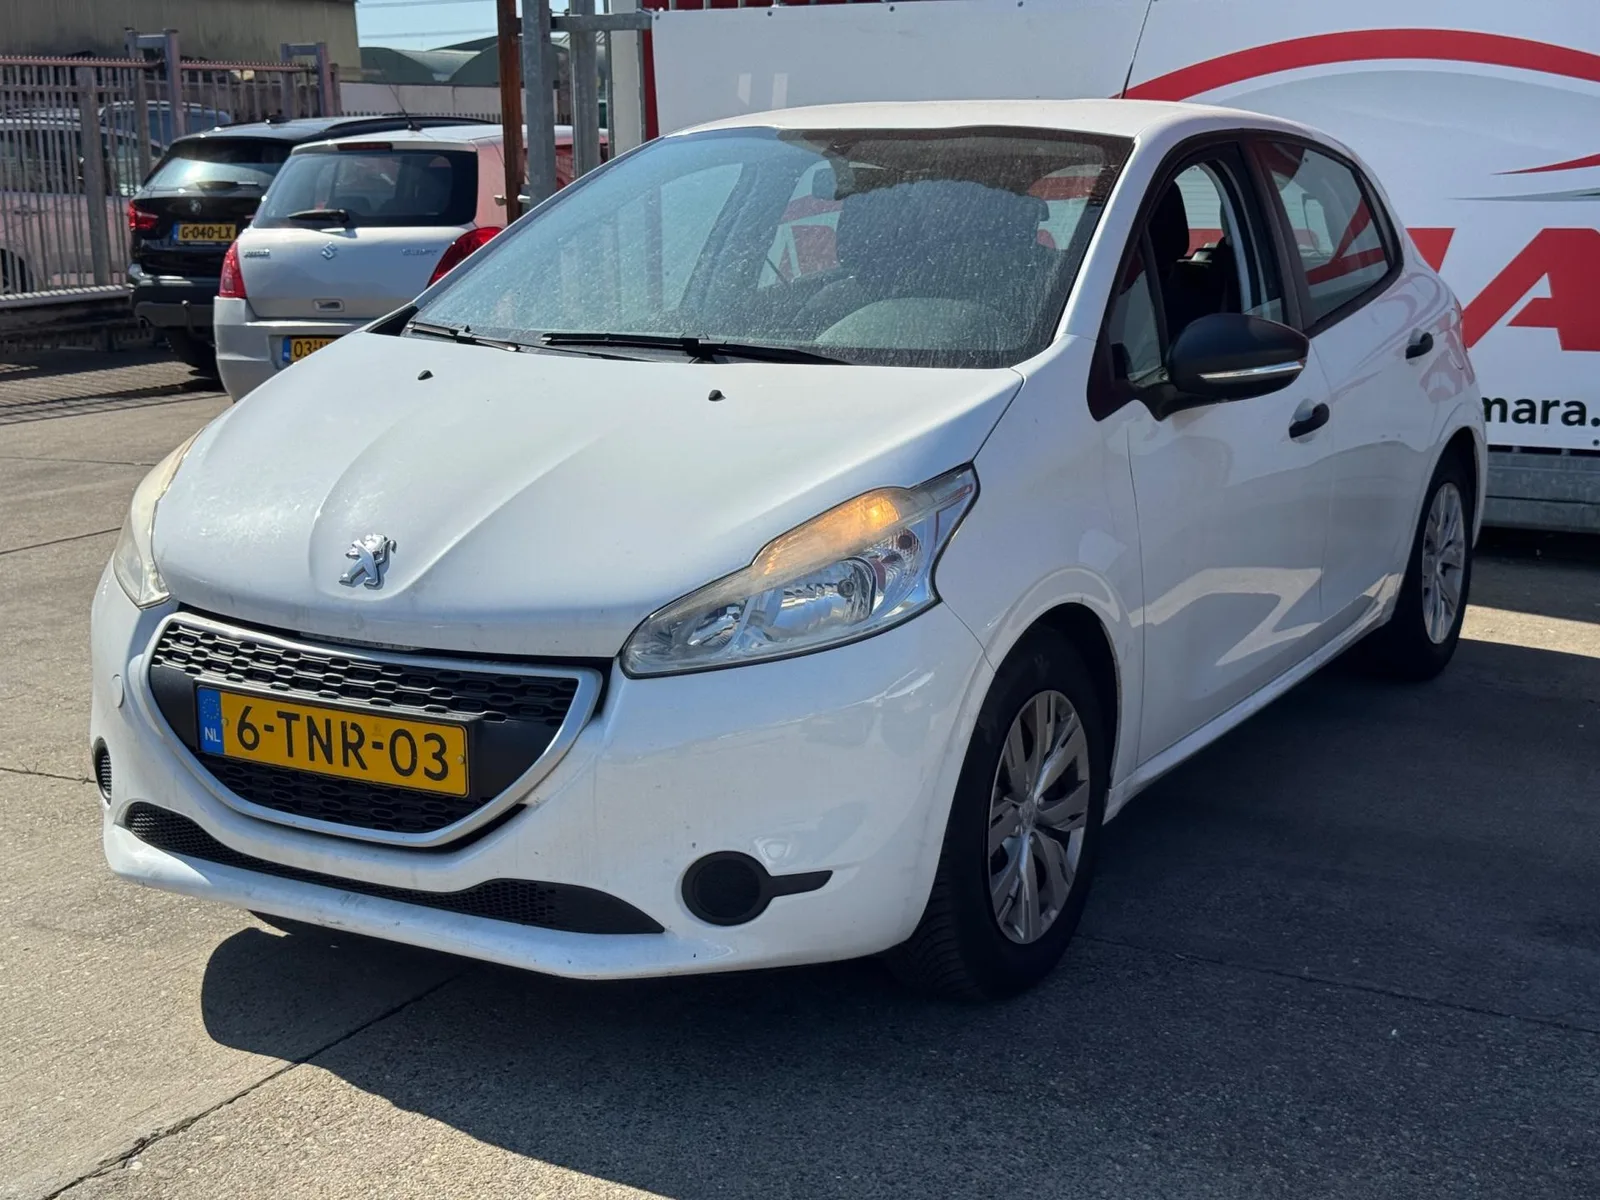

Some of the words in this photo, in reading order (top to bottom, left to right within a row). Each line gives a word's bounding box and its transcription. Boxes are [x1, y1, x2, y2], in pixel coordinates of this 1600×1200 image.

[182, 226, 232, 239] G-040-LX
[204, 726, 221, 743] NL
[236, 705, 450, 781] 6-TNR-03
